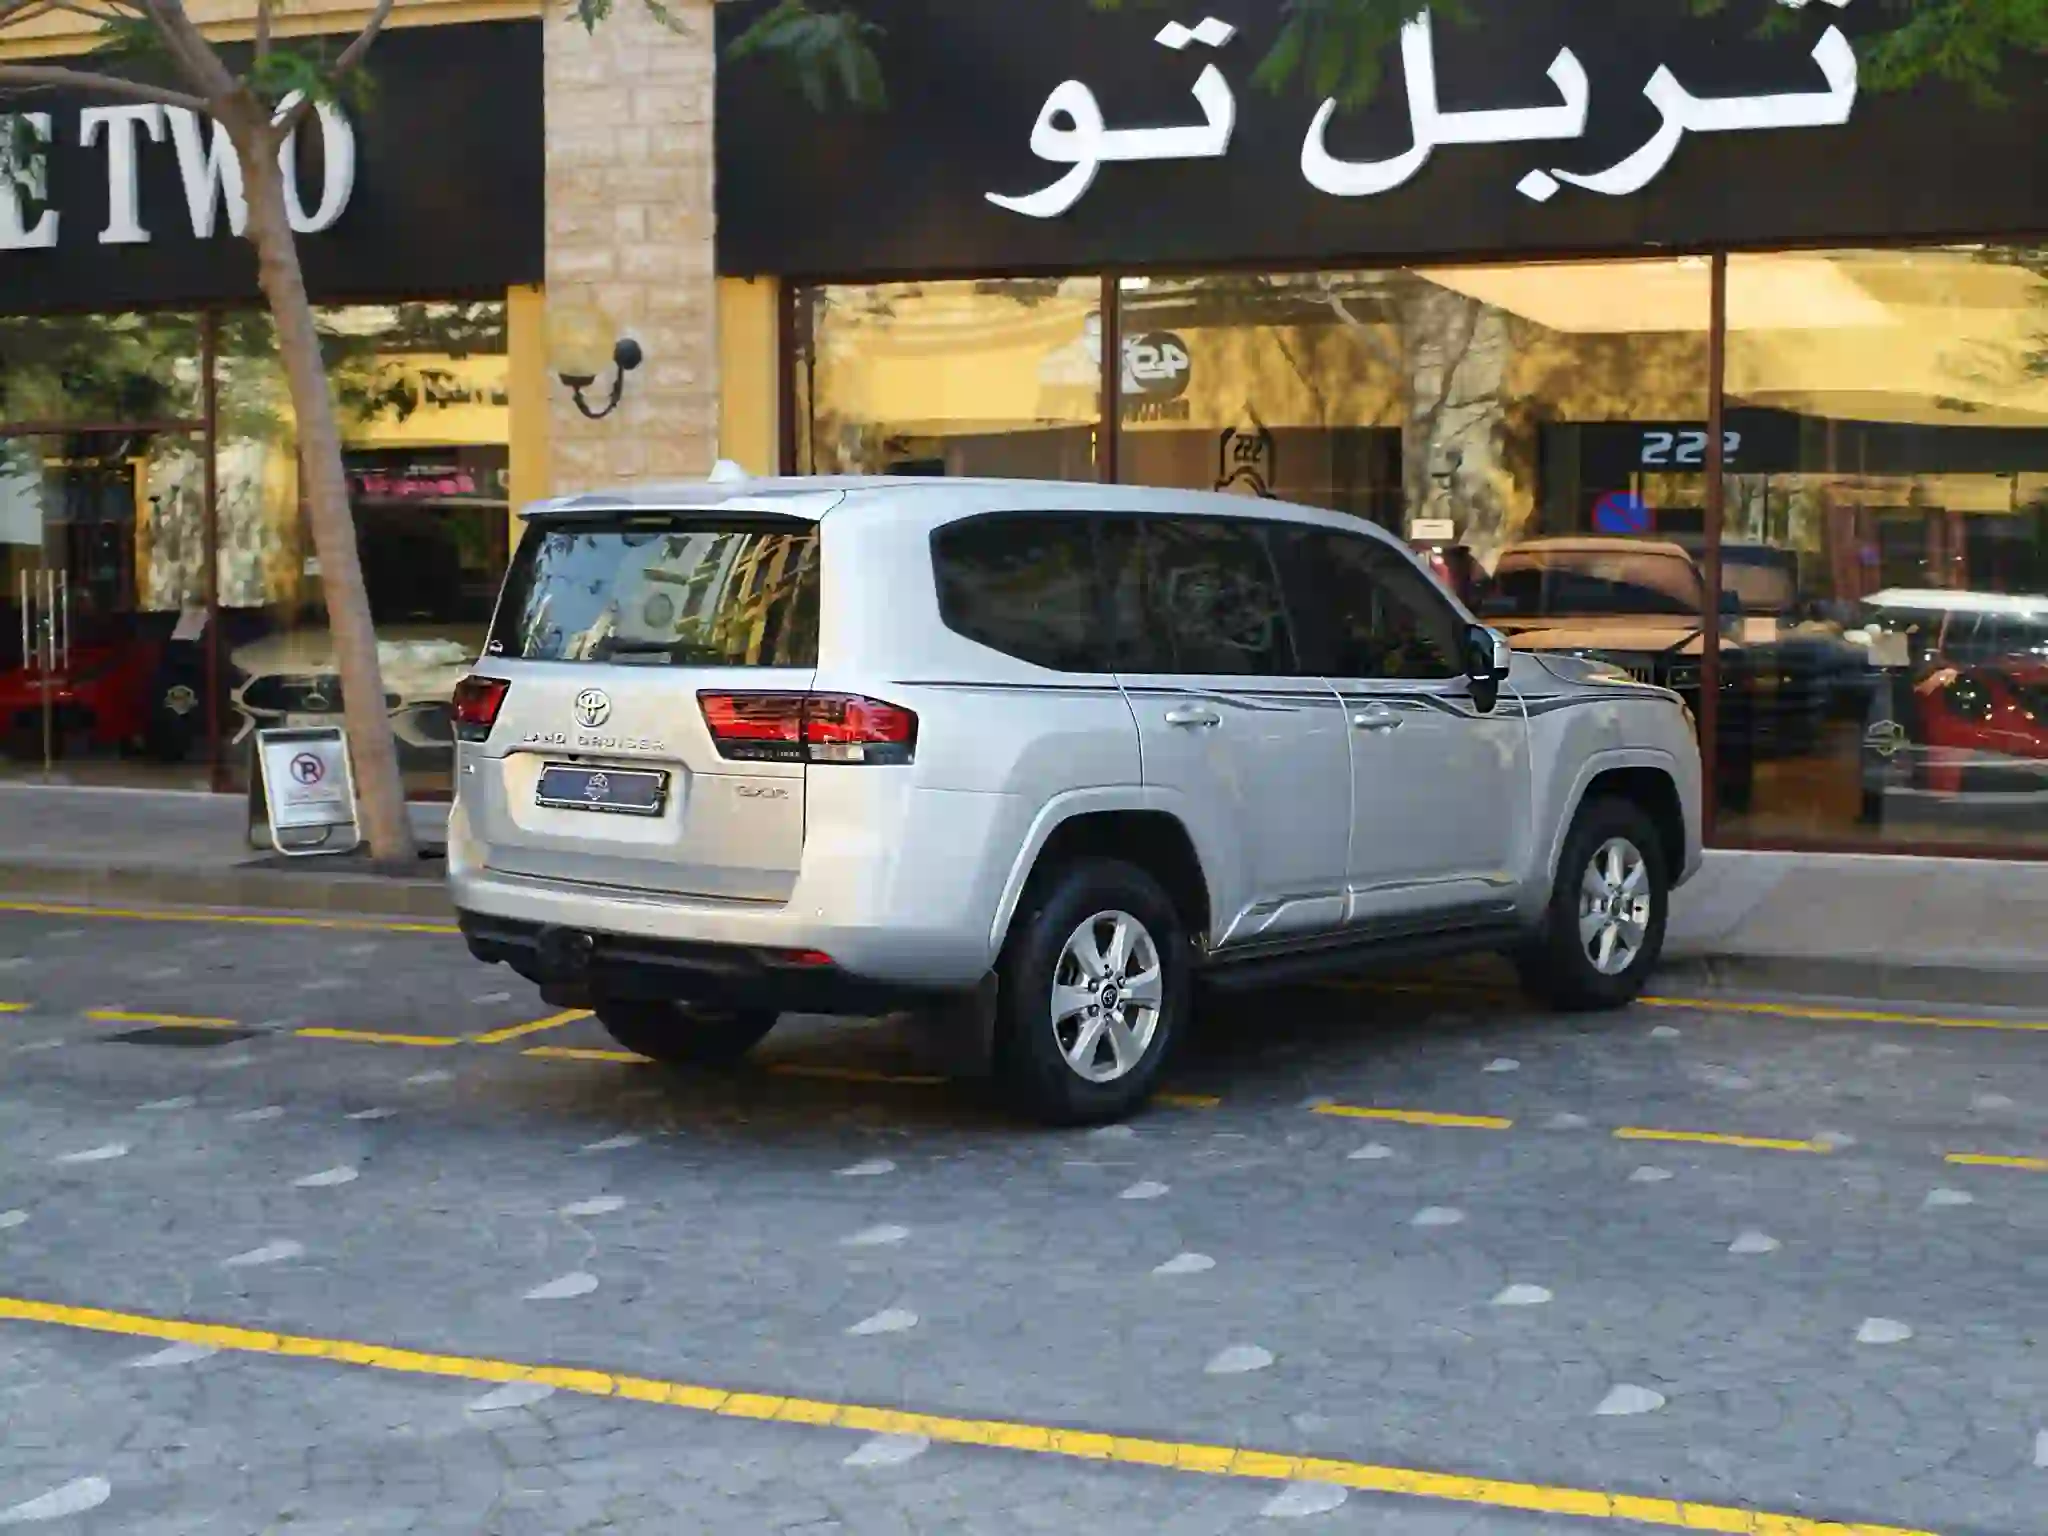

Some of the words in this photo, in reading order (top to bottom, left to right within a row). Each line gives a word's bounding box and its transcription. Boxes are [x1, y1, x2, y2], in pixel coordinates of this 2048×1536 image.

[80, 89, 356, 244] TWO
[984, 15, 1239, 219] تو
[1640, 431, 1742, 464] 222
